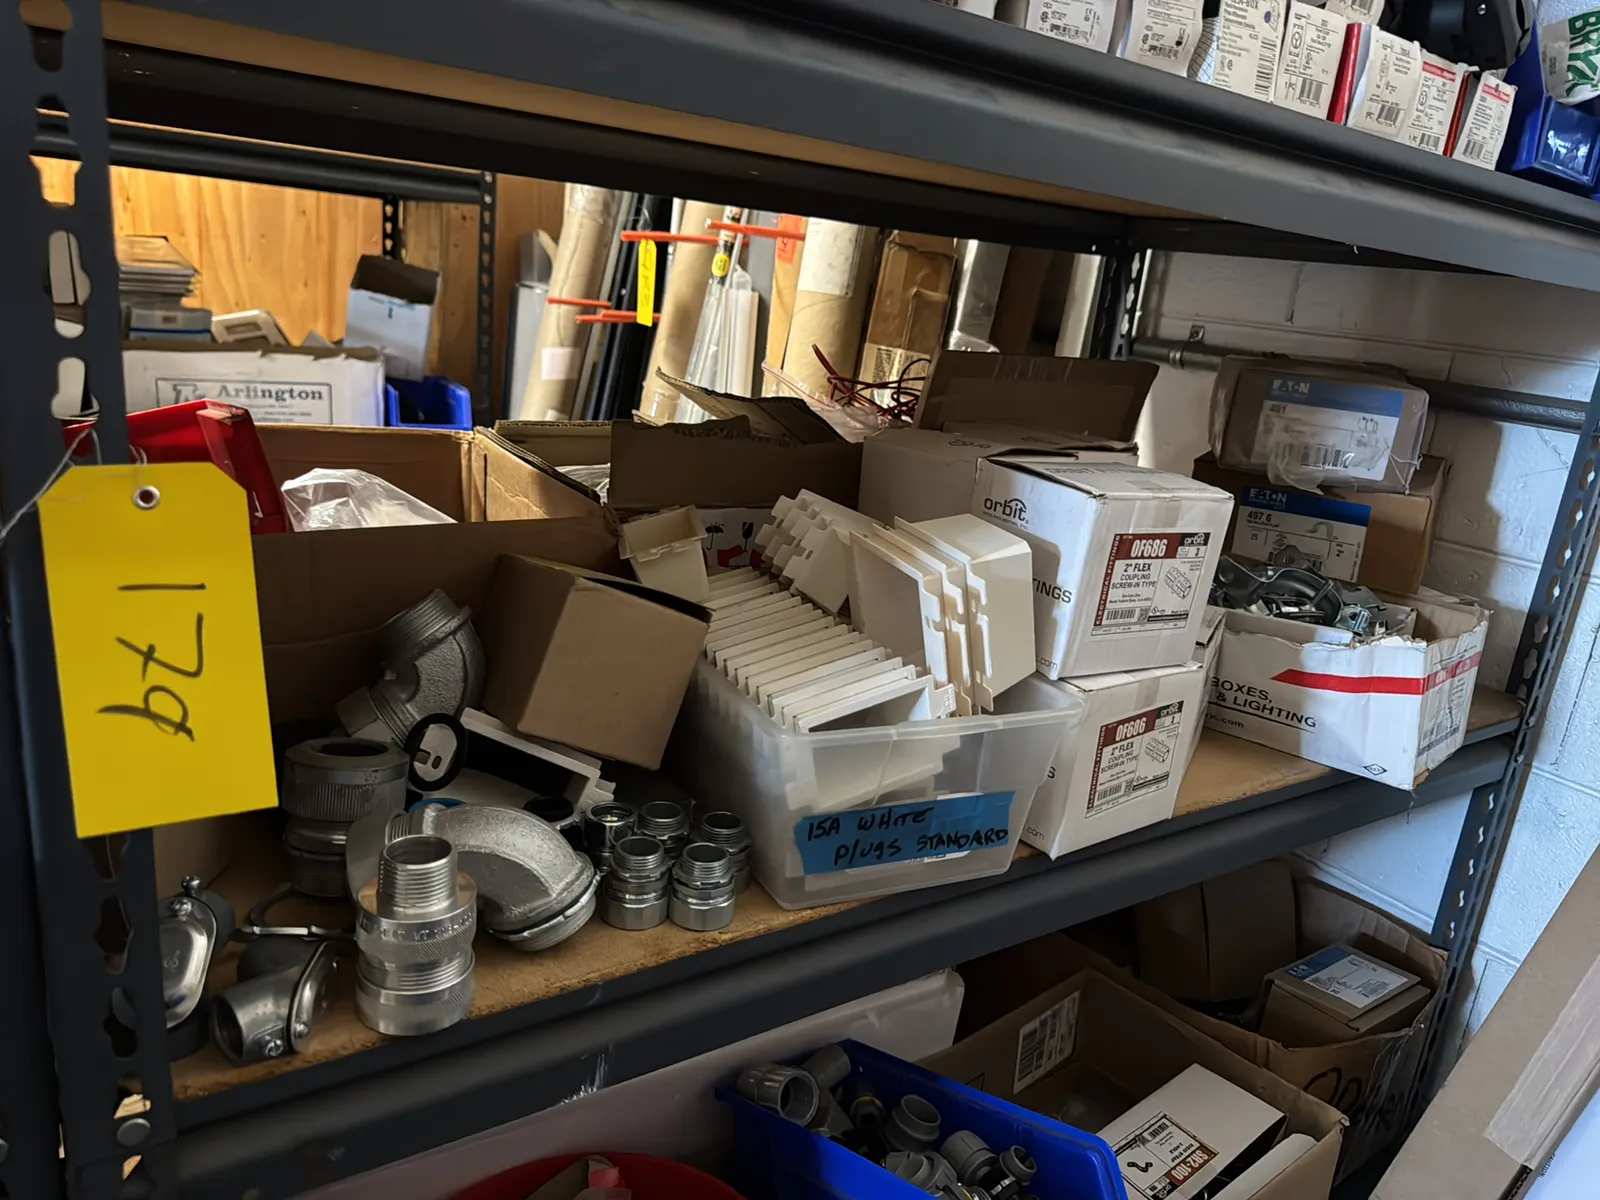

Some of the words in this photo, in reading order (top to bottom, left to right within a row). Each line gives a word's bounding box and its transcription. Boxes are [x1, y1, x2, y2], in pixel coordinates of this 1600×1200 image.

[216, 384, 324, 402] Arlington
[984, 498, 1026, 522] orbit
[1184, 533, 1205, 544] orbit
[1130, 539, 1168, 558] OF686
[1195, 548, 1200, 556] 3
[1133, 563, 1152, 572] FLEX
[1096, 577, 1110, 625] ELECTRICAL
[1107, 536, 1120, 574] FITTINGS
[1111, 582, 1140, 590] SCREW-IN
[97, 583, 206, 741] 179
[1160, 702, 1179, 716] orbit
[1216, 692, 1226, 702] &
[1233, 696, 1316, 728] LIGHTING
[1116, 717, 1146, 741] OF686
[1119, 741, 1134, 752] FLEX
[1100, 759, 1126, 774] SCREW-IN
[1126, 755, 1138, 764] TYPE
[1108, 750, 1134, 764] COUPLING
[1088, 761, 1100, 808] ELECTRICAL
[808, 817, 840, 842] 15A
[858, 806, 936, 832] WHITE
[916, 828, 1009, 852] STANDARD
